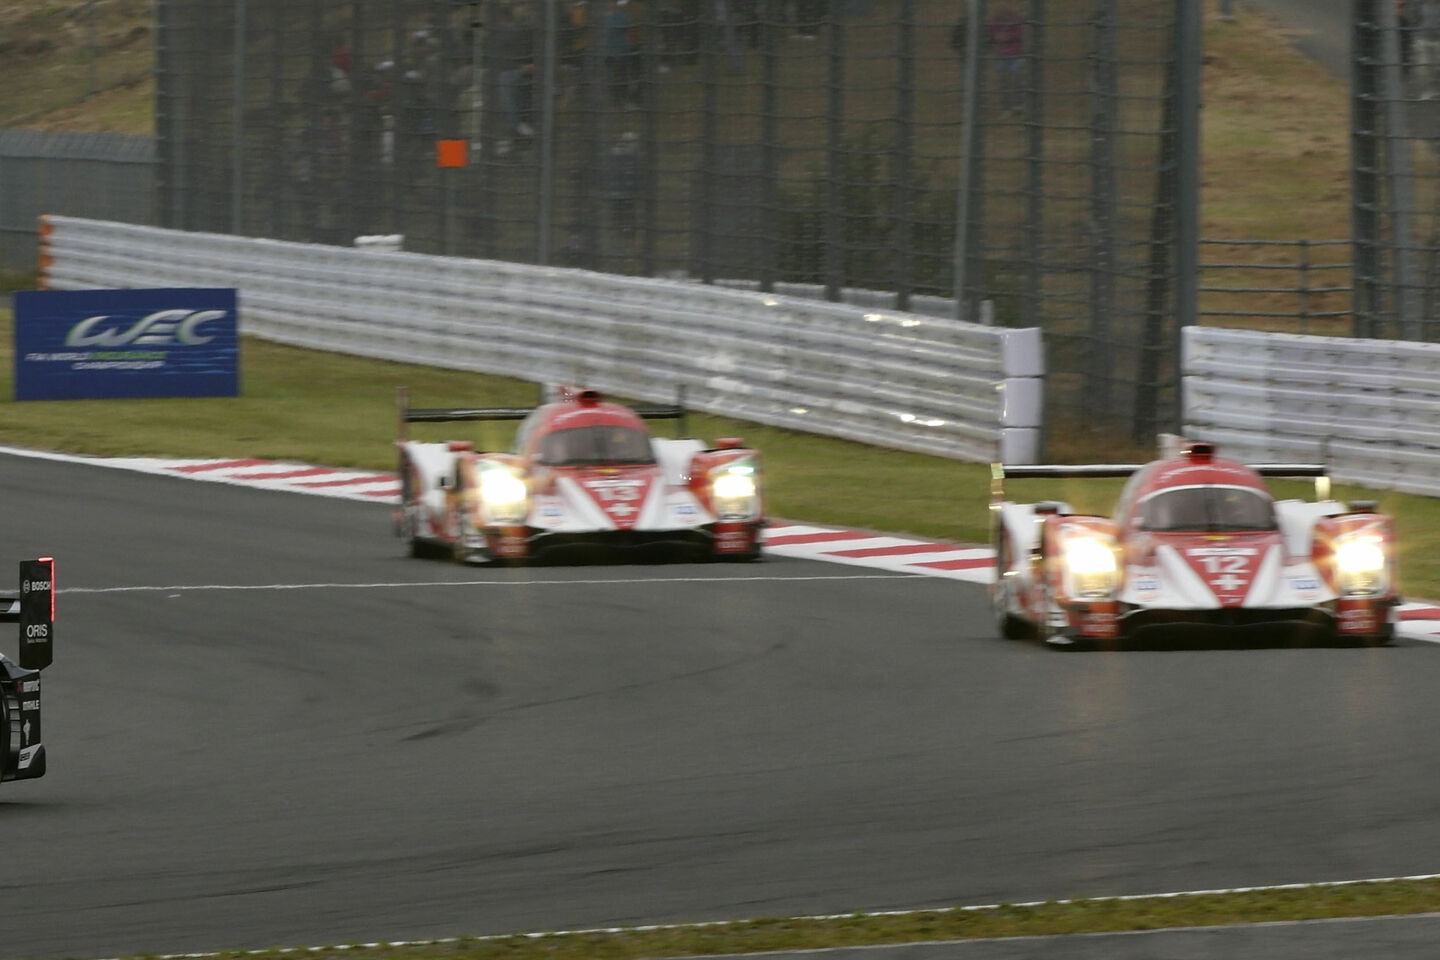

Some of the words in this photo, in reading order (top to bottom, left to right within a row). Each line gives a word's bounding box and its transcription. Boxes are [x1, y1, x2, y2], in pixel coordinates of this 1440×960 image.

[64, 308, 228, 347] WEC
[1198, 555, 1252, 574] 12
[31, 581, 51, 591] BOSCH
[26, 624, 48, 638] ORIS
